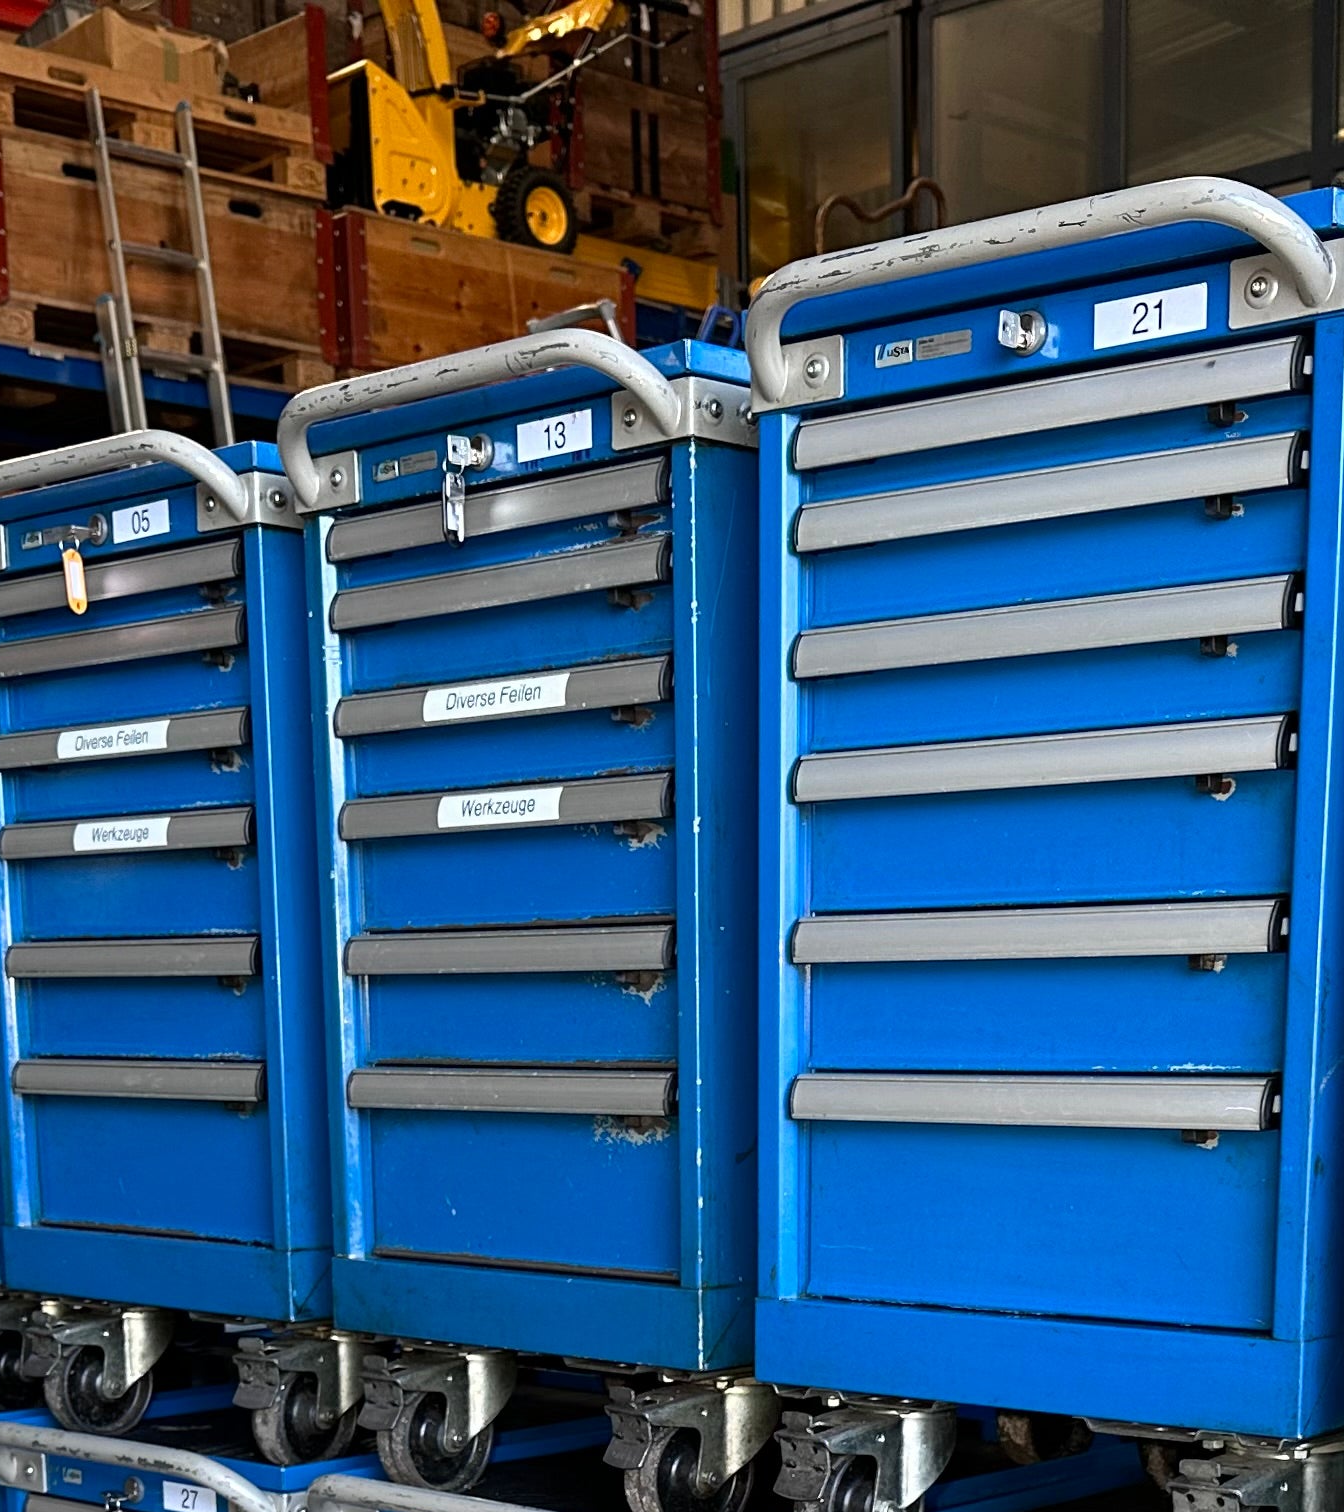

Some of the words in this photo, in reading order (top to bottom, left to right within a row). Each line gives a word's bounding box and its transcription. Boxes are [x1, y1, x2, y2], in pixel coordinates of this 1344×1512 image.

[1132, 298, 1164, 335] 21
[887, 345, 909, 358] LISTA
[543, 421, 566, 450] 13
[131, 510, 151, 534] 05
[446, 691, 496, 711] Diverse
[499, 684, 541, 704] Feilen
[75, 735, 113, 751] Diverse
[116, 729, 149, 746] Feilen
[461, 798, 536, 818] Werkzeuge
[92, 827, 150, 843] Werkzeuge
[181, 1489, 198, 1510] 27
